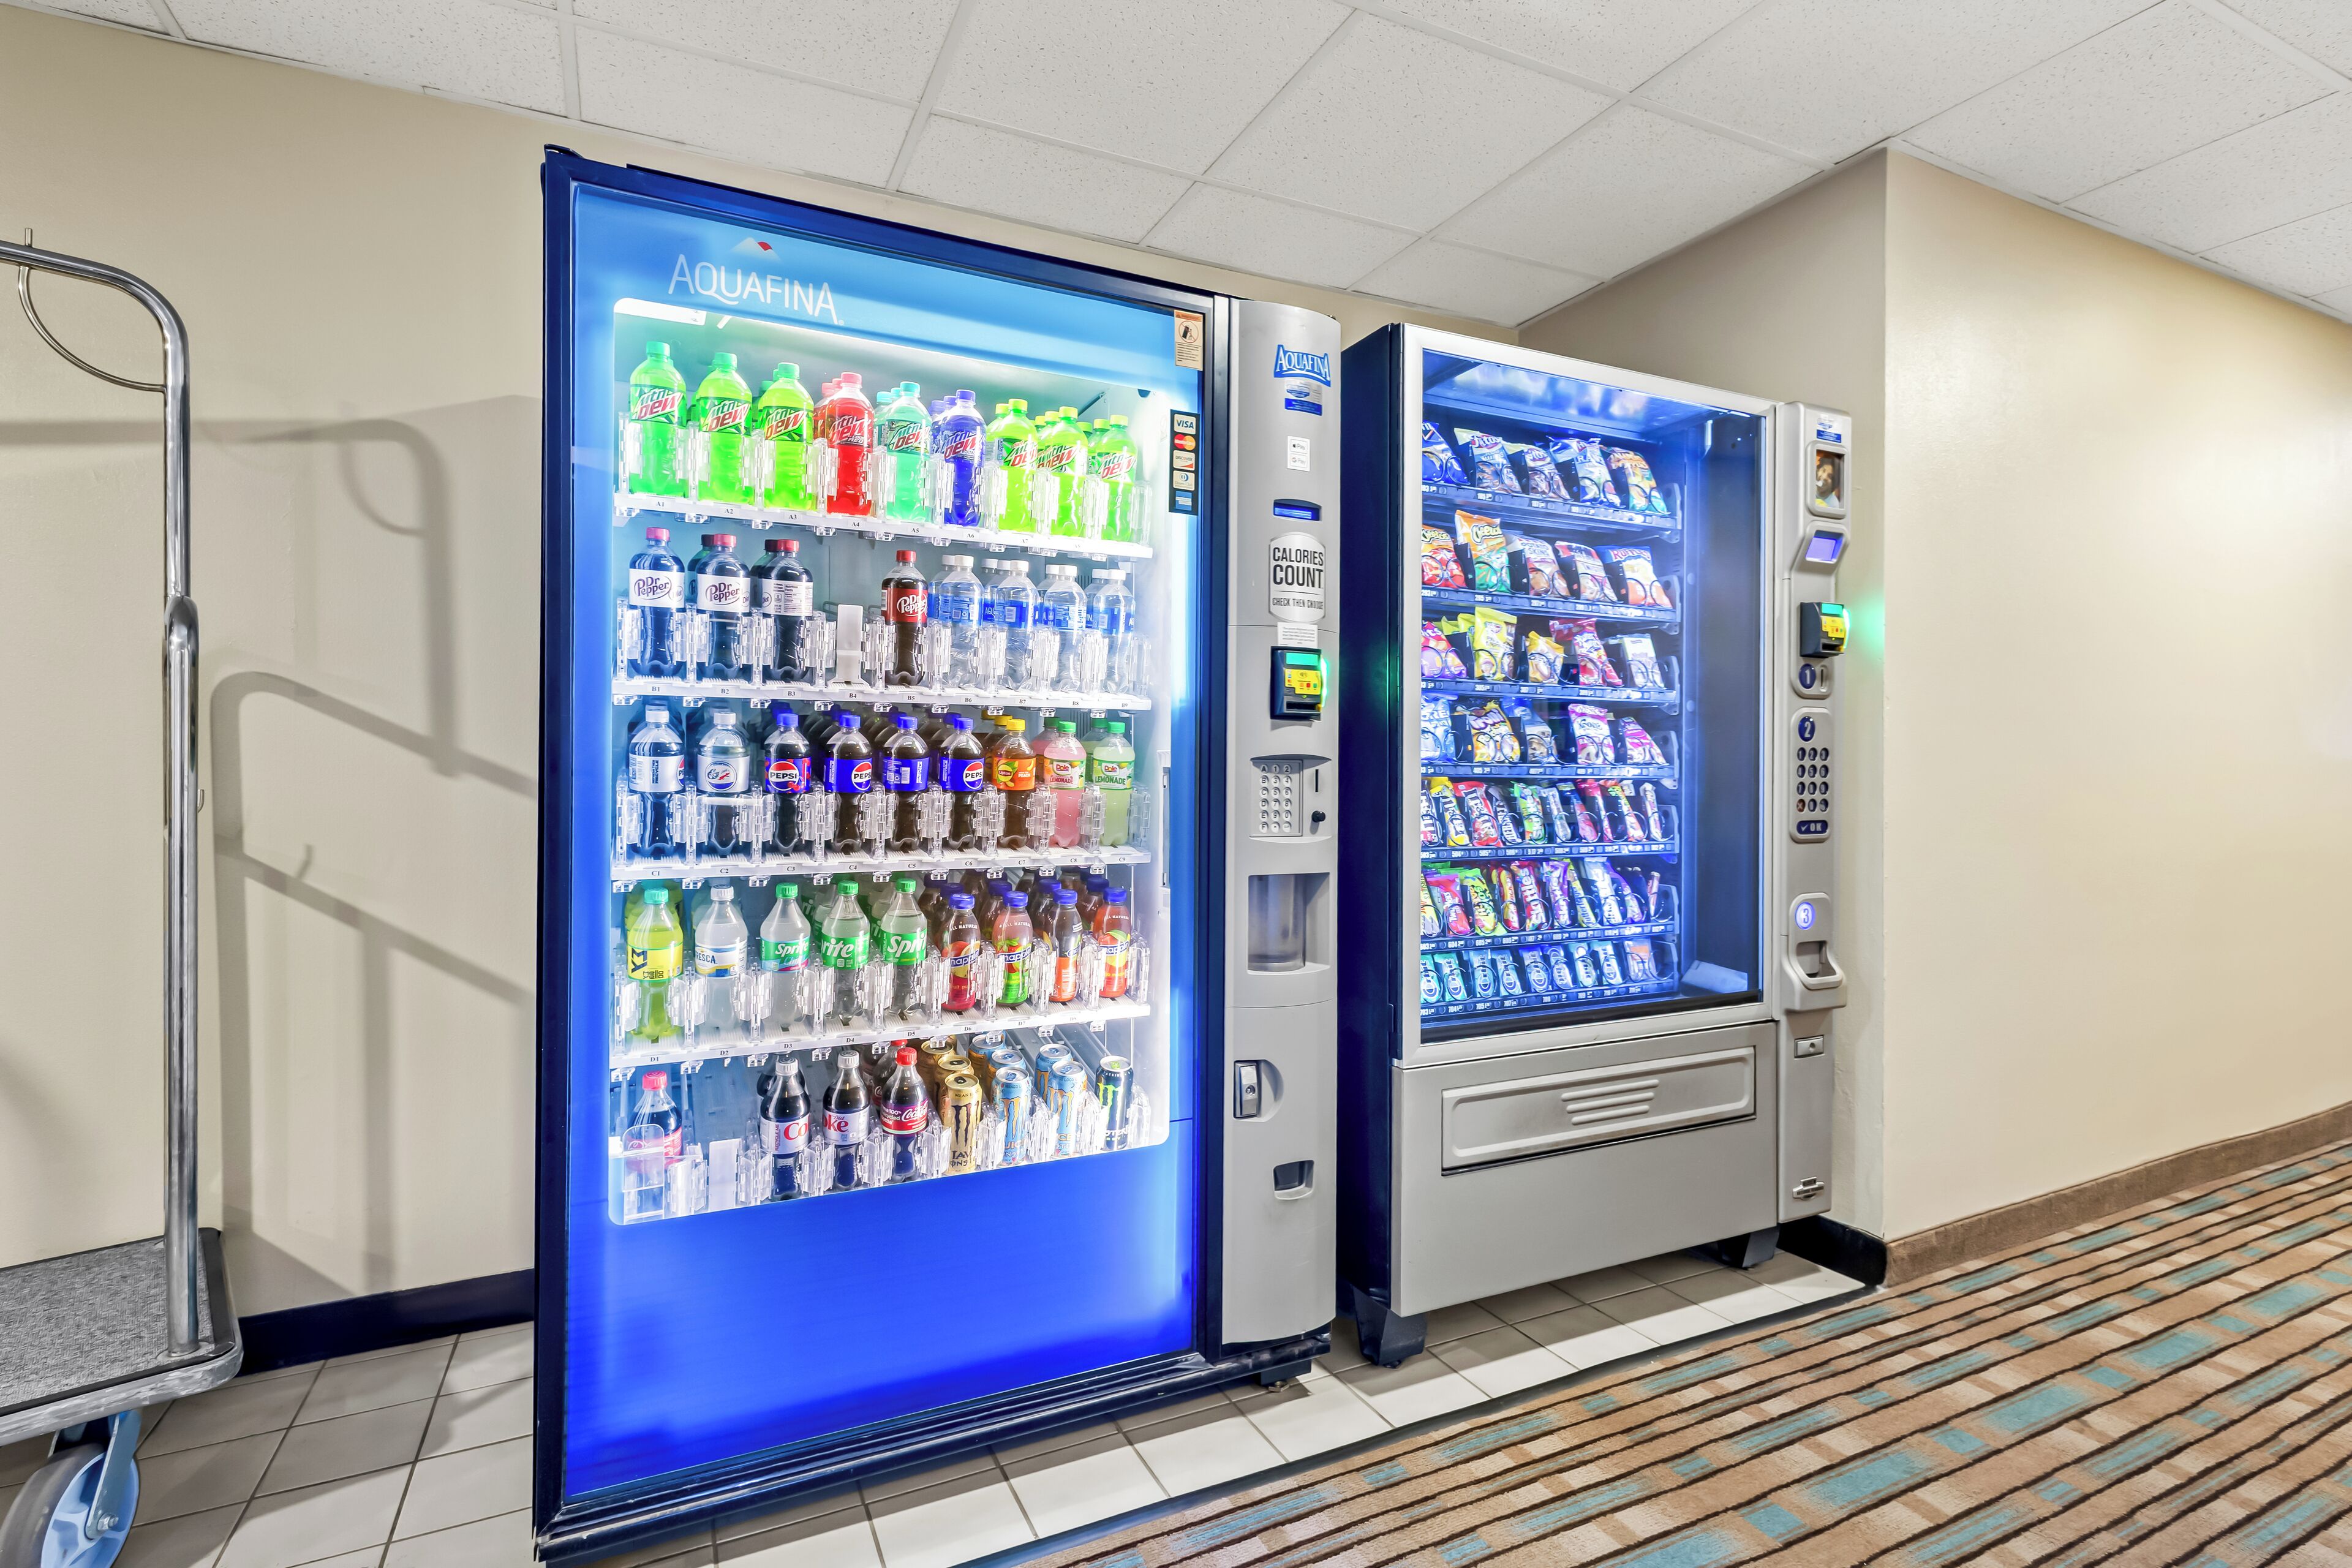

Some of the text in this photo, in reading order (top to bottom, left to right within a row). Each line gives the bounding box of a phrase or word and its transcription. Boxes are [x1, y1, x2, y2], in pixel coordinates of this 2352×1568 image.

[668, 254, 839, 325] AQUAFINA
[1276, 347, 1330, 382] AQUAFINA
[1176, 420, 1194, 429] VISA
[1471, 434, 1502, 447] Fritos
[1273, 546, 1324, 567] CALORIES
[1613, 548, 1651, 560] RUFFLES
[645, 576, 660, 589] Dr
[1273, 564, 1324, 589] COUNT
[635, 578, 669, 597] Pepper
[709, 584, 740, 603] Pepper
[718, 582, 732, 594] Dr
[1272, 597, 1291, 606] CHECK
[1292, 598, 1306, 608] THEN
[1805, 668, 1811, 684] 1
[1804, 721, 1811, 737] 2
[1095, 776, 1126, 785] LEMONADE
[1810, 823, 1822, 831] OK
[1521, 867, 1545, 924] Skittles
[1803, 907, 1810, 924] 3
[695, 952, 717, 965] RESCA
[1477, 954, 1493, 993] Orbit
